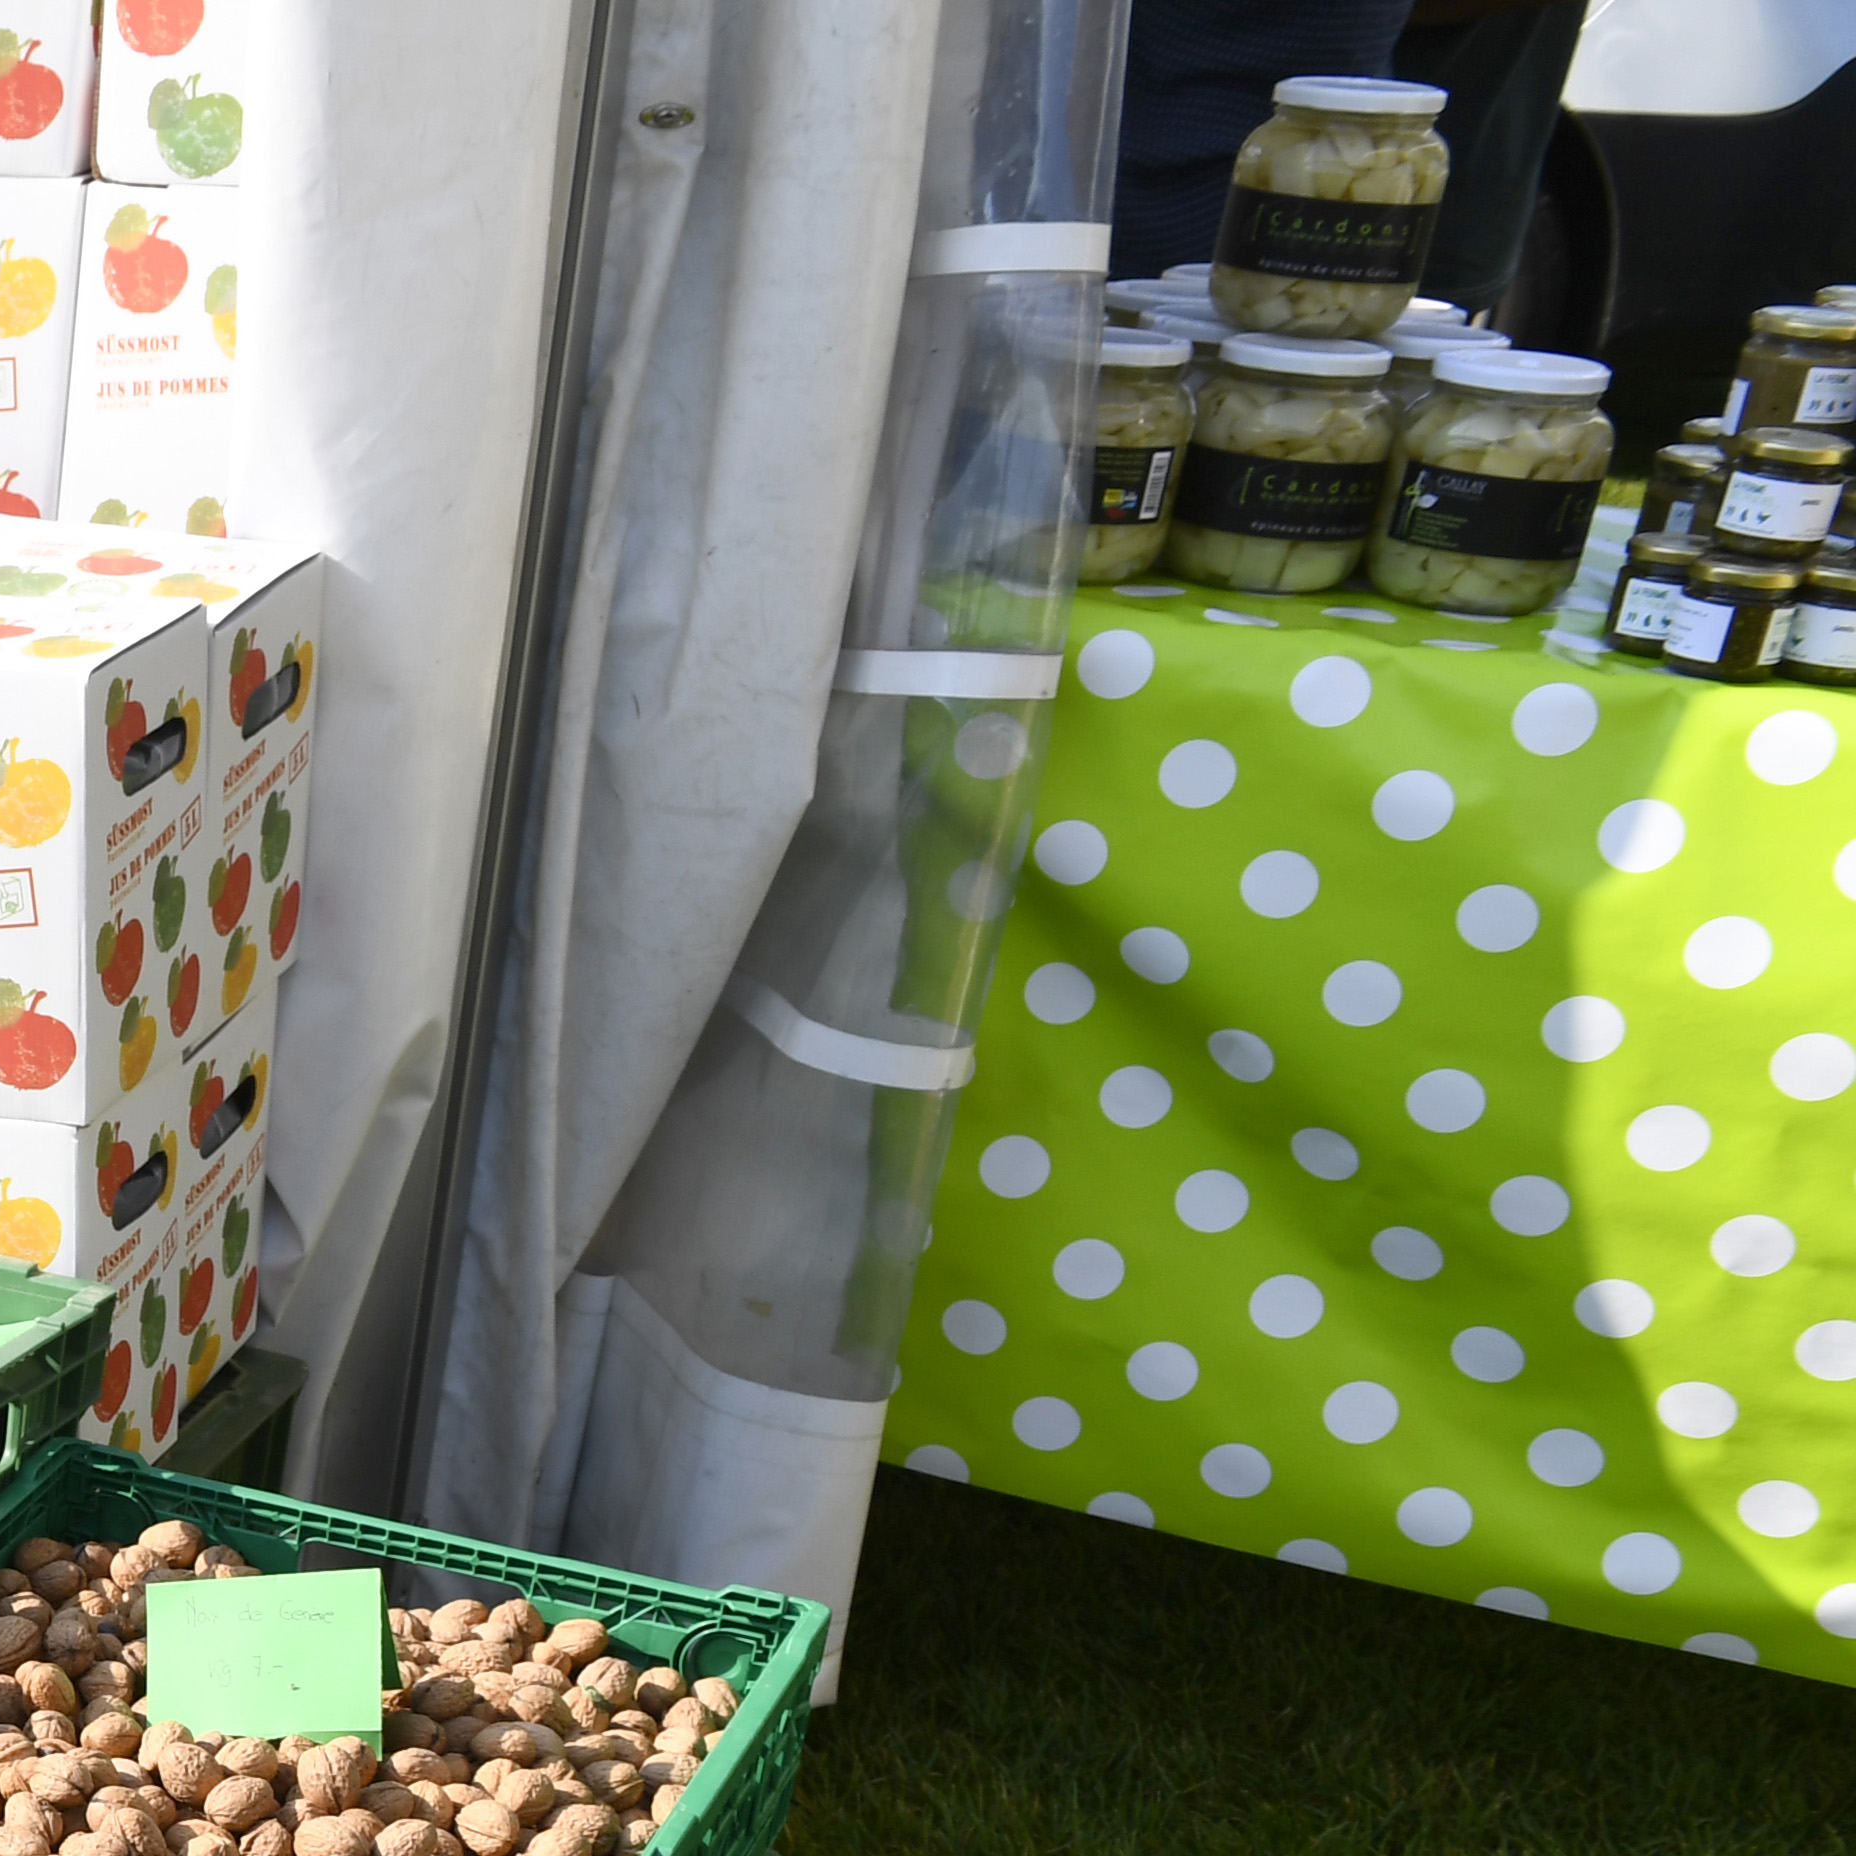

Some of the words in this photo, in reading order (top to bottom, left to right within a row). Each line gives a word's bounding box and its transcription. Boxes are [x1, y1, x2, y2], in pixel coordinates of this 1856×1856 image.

[1270, 210, 1411, 238] Cardons
[97, 334, 181, 355] SÜSSMOST
[97, 381, 126, 398] JUS
[133, 380, 152, 396] DE
[160, 376, 229, 395] POMMES
[107, 798, 153, 850] SÜSSMOST
[109, 867, 128, 896] JUS
[130, 855, 142, 879] DE
[144, 820, 176, 865] POMMES
[239, 1602, 262, 1622] de
